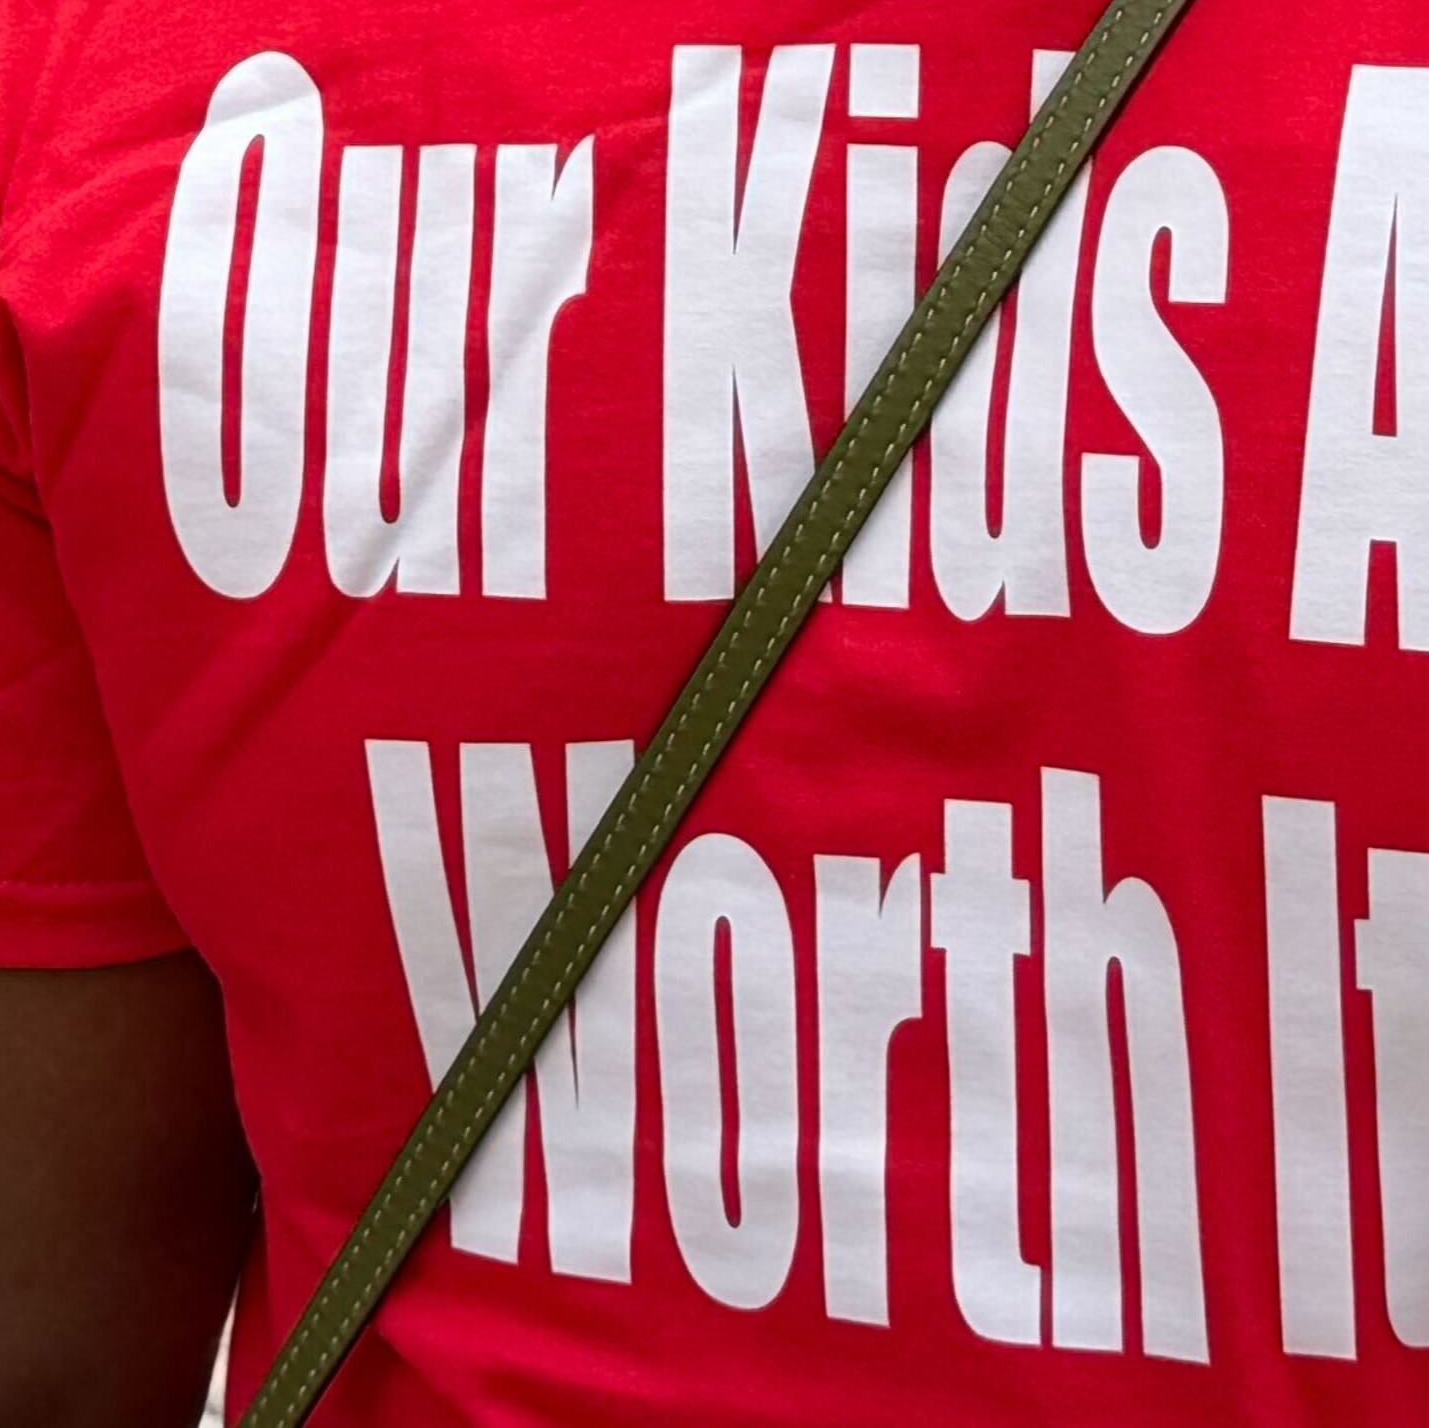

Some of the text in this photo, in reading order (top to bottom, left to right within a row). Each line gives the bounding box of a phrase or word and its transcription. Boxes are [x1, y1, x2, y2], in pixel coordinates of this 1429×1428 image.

[157, 51, 595, 601] Our
[663, 43, 1230, 636] Kids
[365, 739, 1210, 1365] Worth
